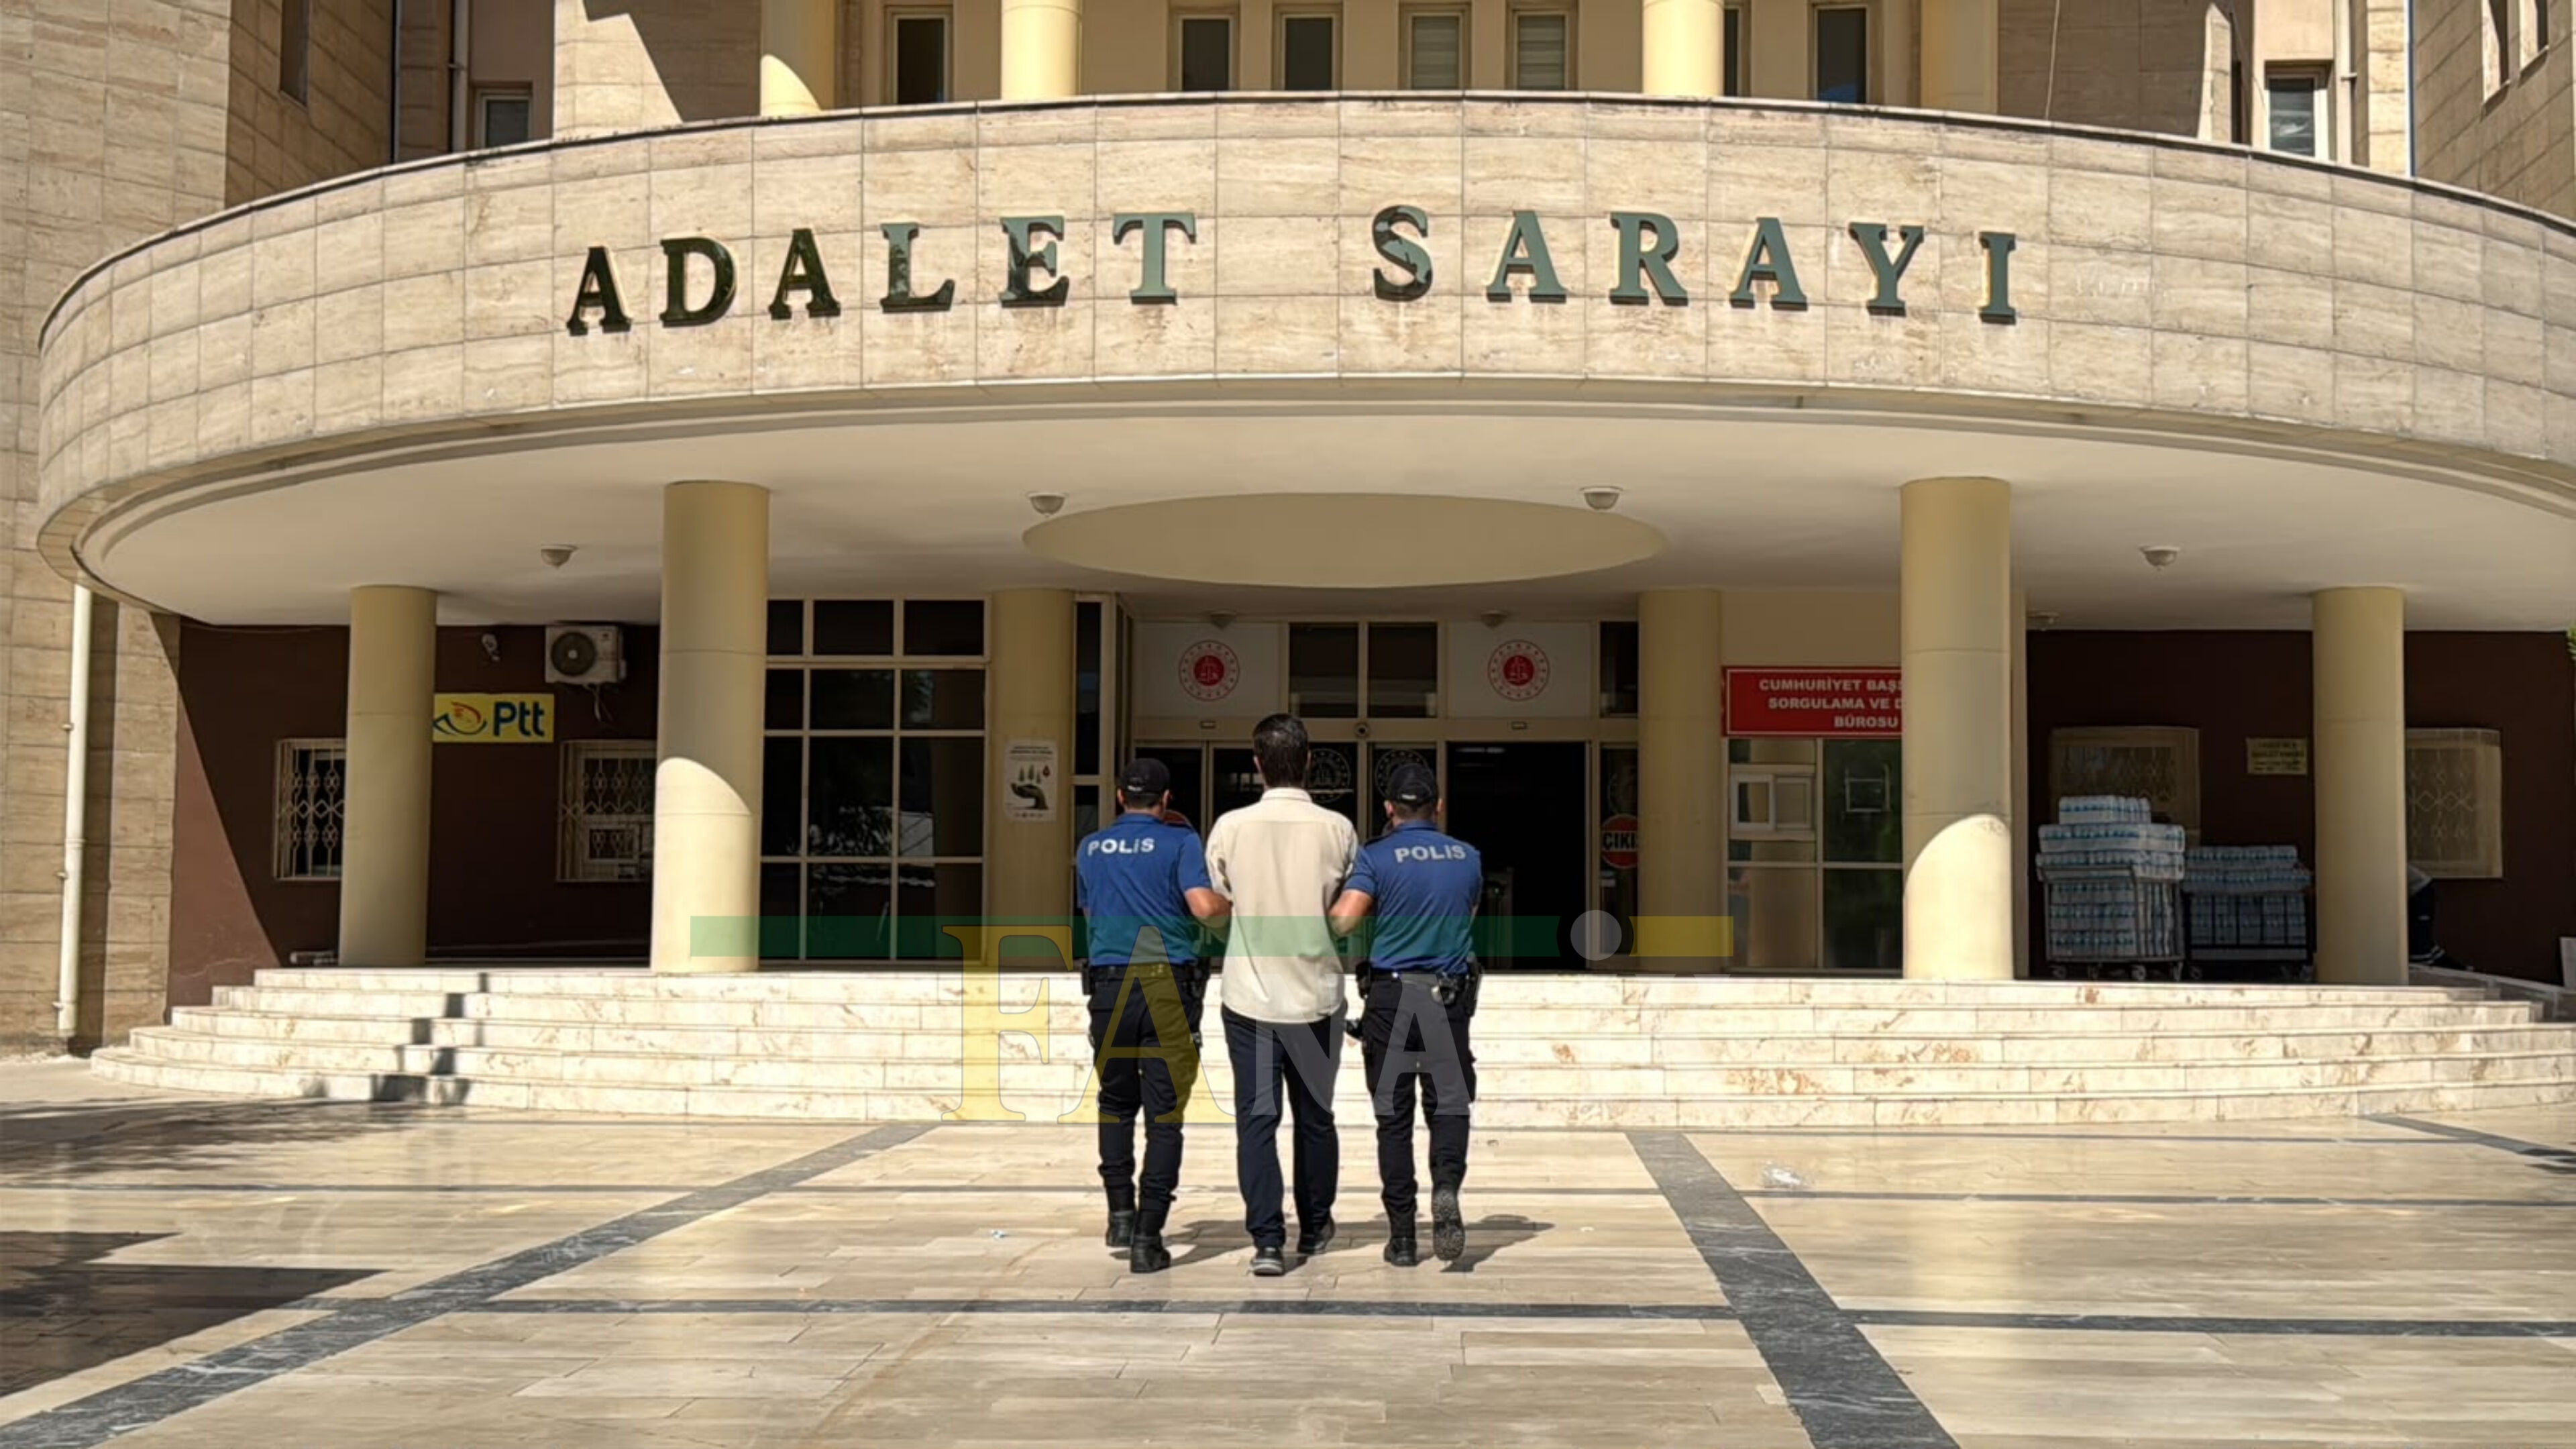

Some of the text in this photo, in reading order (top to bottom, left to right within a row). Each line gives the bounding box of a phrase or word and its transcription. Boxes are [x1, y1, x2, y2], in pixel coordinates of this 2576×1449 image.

[566, 205, 2016, 335] ADALET SARAYI
[1759, 678, 1862, 691] CUMHURİYET
[1768, 697, 1866, 709] SORGULAMA
[1869, 698, 1890, 709] VE
[493, 702, 545, 736] Ptt
[1834, 714, 1898, 728] BÜROSU
[1603, 832, 1638, 850] ÇIKI
